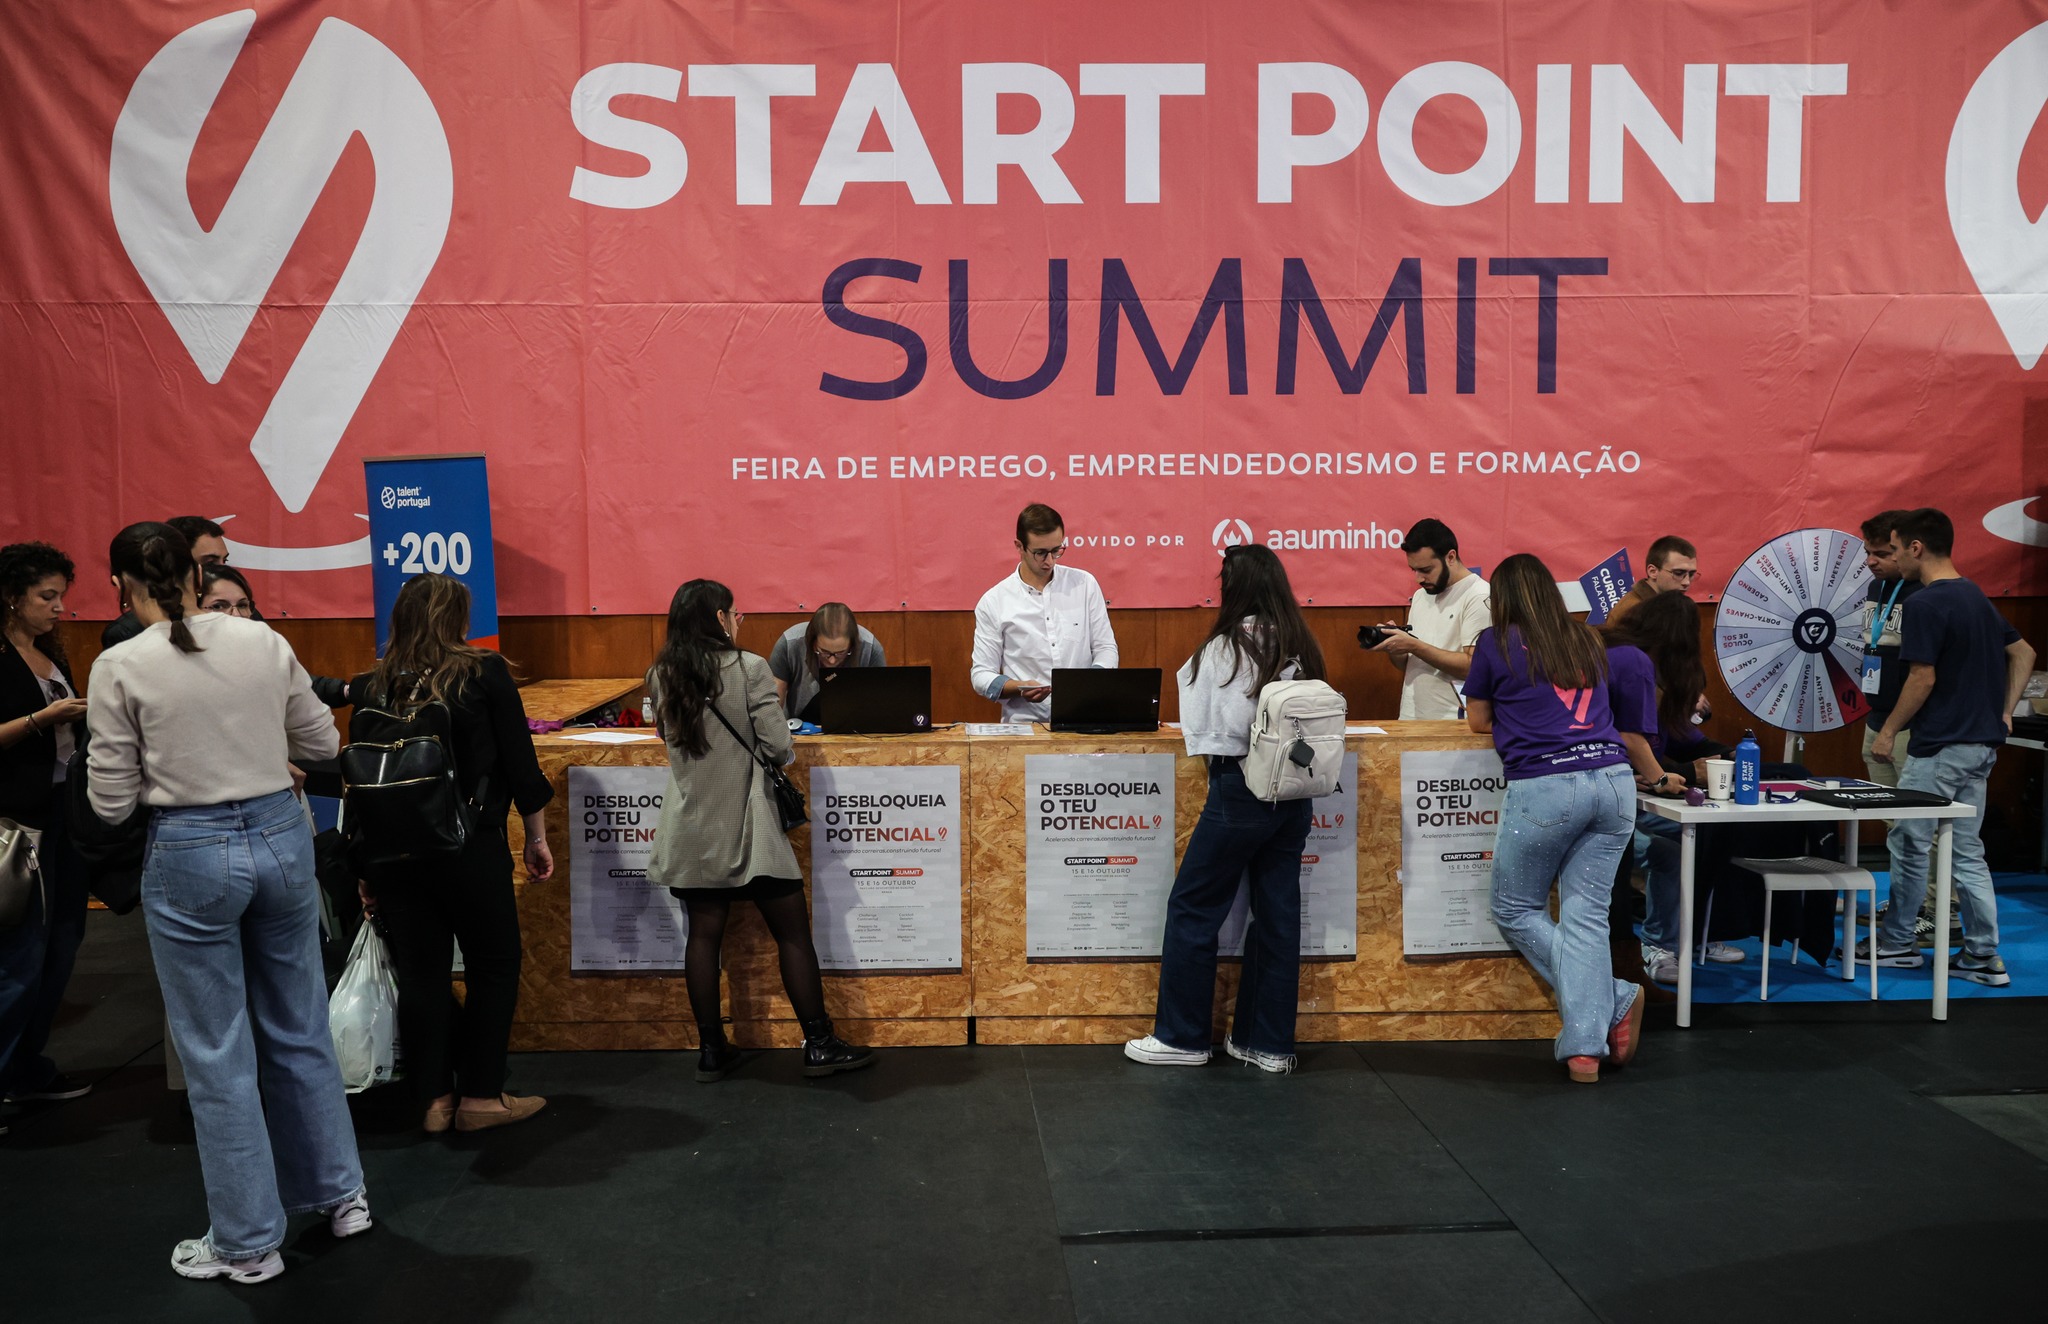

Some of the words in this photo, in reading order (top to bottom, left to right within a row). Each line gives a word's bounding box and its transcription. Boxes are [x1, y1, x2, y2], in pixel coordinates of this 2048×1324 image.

[569, 62, 1206, 209] START
[1257, 61, 1849, 207] POINT
[819, 256, 1608, 401] SUMMIT
[732, 456, 826, 480] FEIRA
[837, 456, 878, 479] DE
[890, 454, 1056, 481] EMPREGO,
[1068, 451, 1418, 477] EMPREENDEDORISMO
[1429, 452, 1446, 474] E
[1457, 444, 1641, 479] FORMAÇÃO
[397, 486, 419, 497] talent
[397, 496, 431, 509] portugal
[1062, 535, 1136, 548] MOVIDO
[1146, 535, 1184, 547] POR
[1266, 521, 1404, 550] aauminho
[383, 532, 472, 575] +200
[1755, 558, 1771, 577] BOLA
[1784, 542, 1807, 600] GUARDA-CHUVA
[1827, 559, 1842, 588] TAPETE
[1838, 539, 1849, 560] RATO
[1760, 554, 1793, 595] ANTI-STRESS
[1592, 576, 1603, 596] FALA
[1599, 596, 1609, 613] POR
[1737, 579, 1769, 603] CADERNO
[1725, 608, 1781, 626] PORTA-CHAVES
[1722, 634, 1737, 642] SOL
[1729, 657, 1758, 674] CANETA
[1761, 661, 1784, 684] TAPETE
[1745, 682, 1762, 699] RATO
[1795, 664, 1811, 725] GUARDA-CHUVA
[1768, 683, 1789, 716] GARRAFA
[1815, 675, 1828, 724] ANTI-STRESS
[1825, 702, 1834, 723] BOLA
[1040, 782, 1161, 796] DESBLOQUEIA
[1417, 778, 1507, 793] DESBLOQU
[584, 795, 662, 809] DESBLOQ
[825, 795, 946, 809] DESBLOQUEIA
[1040, 799, 1056, 813] O
[1059, 799, 1097, 812] TEU
[1416, 796, 1431, 810] O
[1436, 795, 1472, 809] TEU
[584, 811, 598, 825] O
[603, 811, 641, 825] TEU
[826, 811, 840, 825] O
[844, 811, 882, 825] TEU
[1041, 815, 1149, 830] POTENCIAL
[1417, 811, 1499, 827] POTENCI
[826, 828, 935, 842] POTENCIAL
